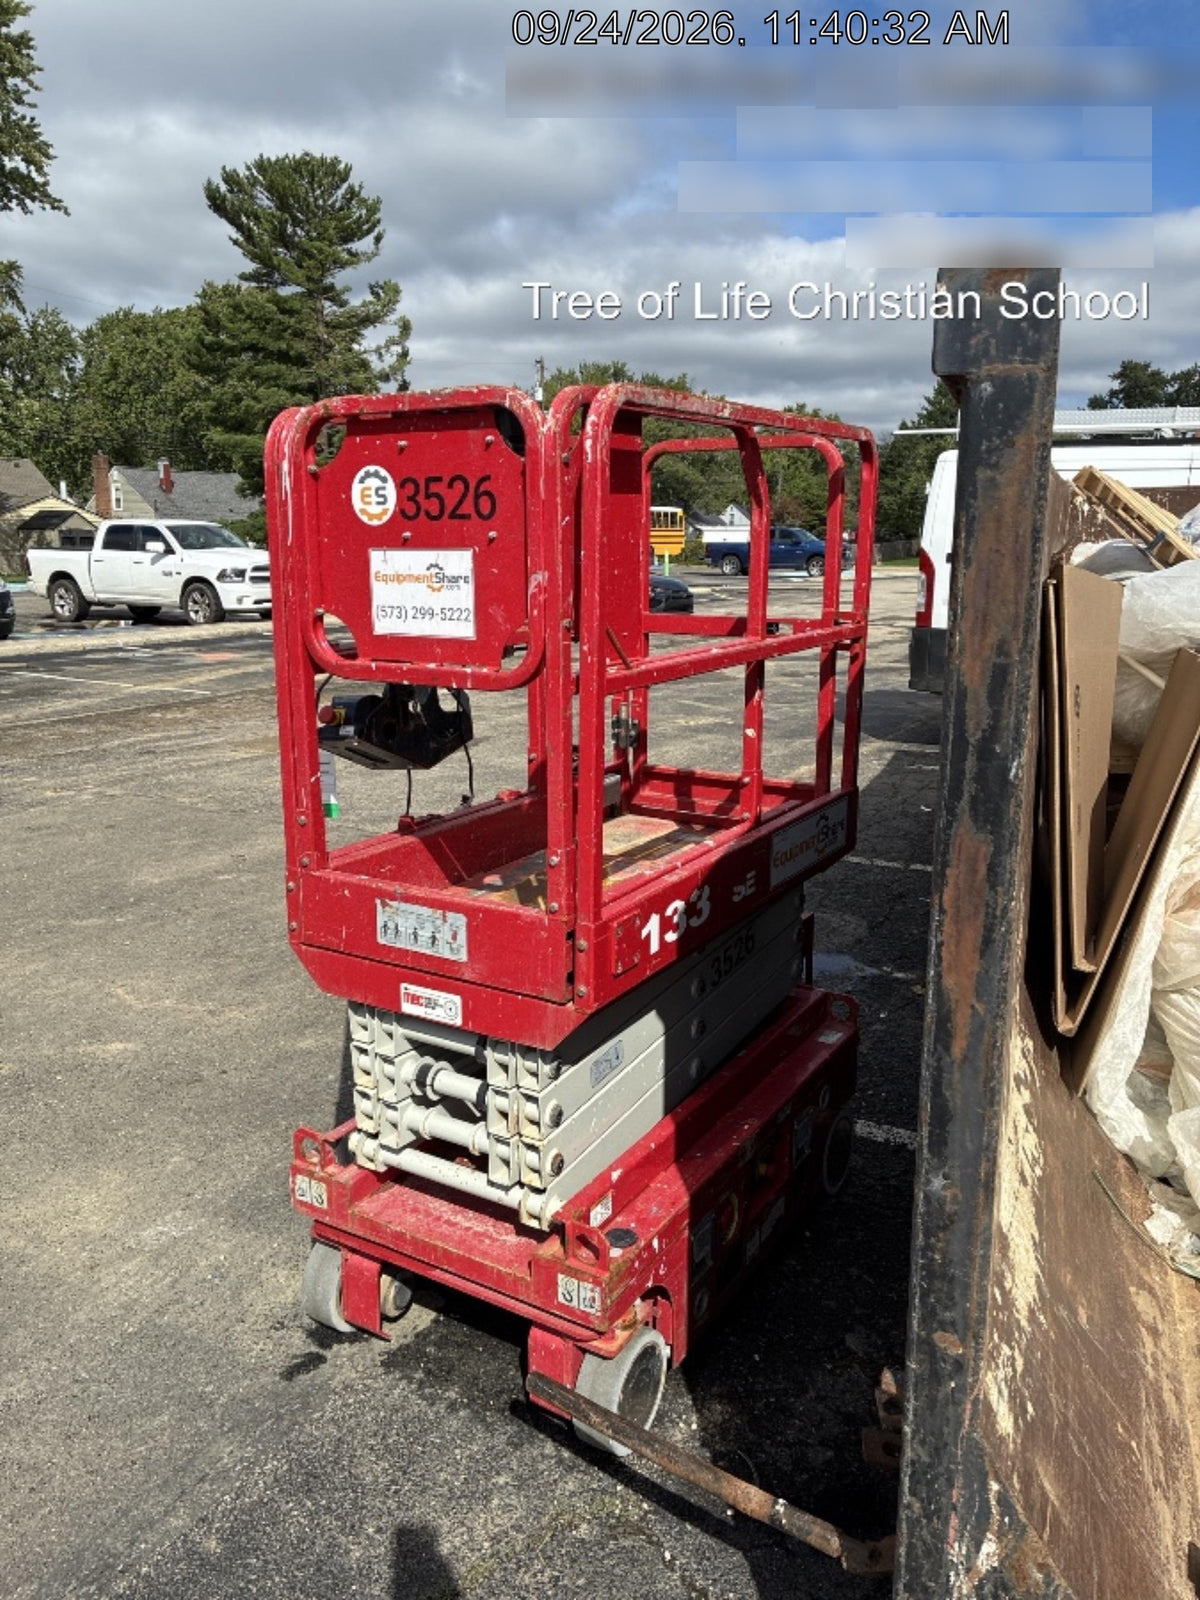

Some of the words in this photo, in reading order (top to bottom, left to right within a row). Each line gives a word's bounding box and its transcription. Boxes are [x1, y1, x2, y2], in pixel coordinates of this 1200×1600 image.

[359, 486, 388, 506] ES
[399, 474, 497, 521] 3526
[374, 570, 470, 585] EquipmentShare
[376, 606, 408, 621] (573)
[411, 606, 472, 622] 299-5222
[711, 929, 756, 986] 3526
